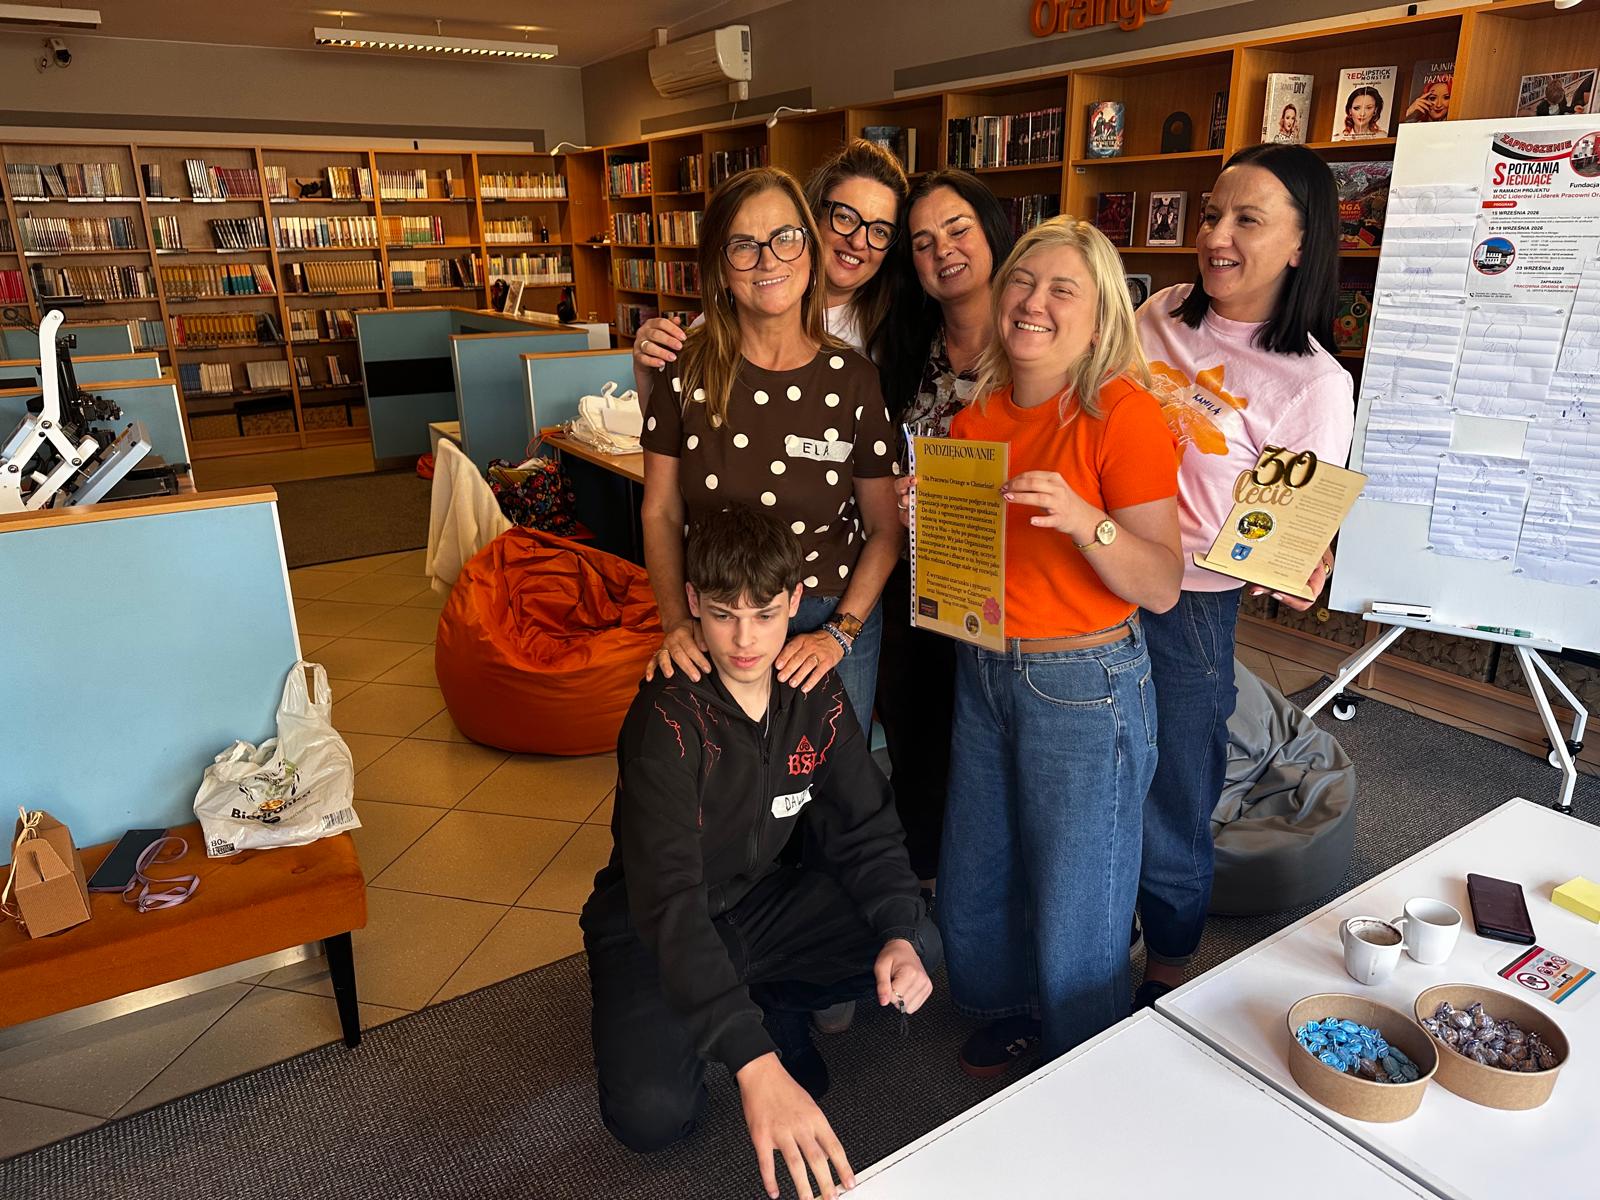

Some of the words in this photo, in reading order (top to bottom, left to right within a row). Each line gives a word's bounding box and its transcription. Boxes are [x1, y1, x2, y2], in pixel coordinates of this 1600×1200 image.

[1500, 133, 1572, 154] ZAPROSZENIE
[1192, 394, 1222, 415] KAMILA
[802, 442, 830, 456] ELA
[923, 443, 996, 461] PODZIĘKOWANIE
[1251, 444, 1318, 488] 30
[1232, 469, 1294, 506] lecie
